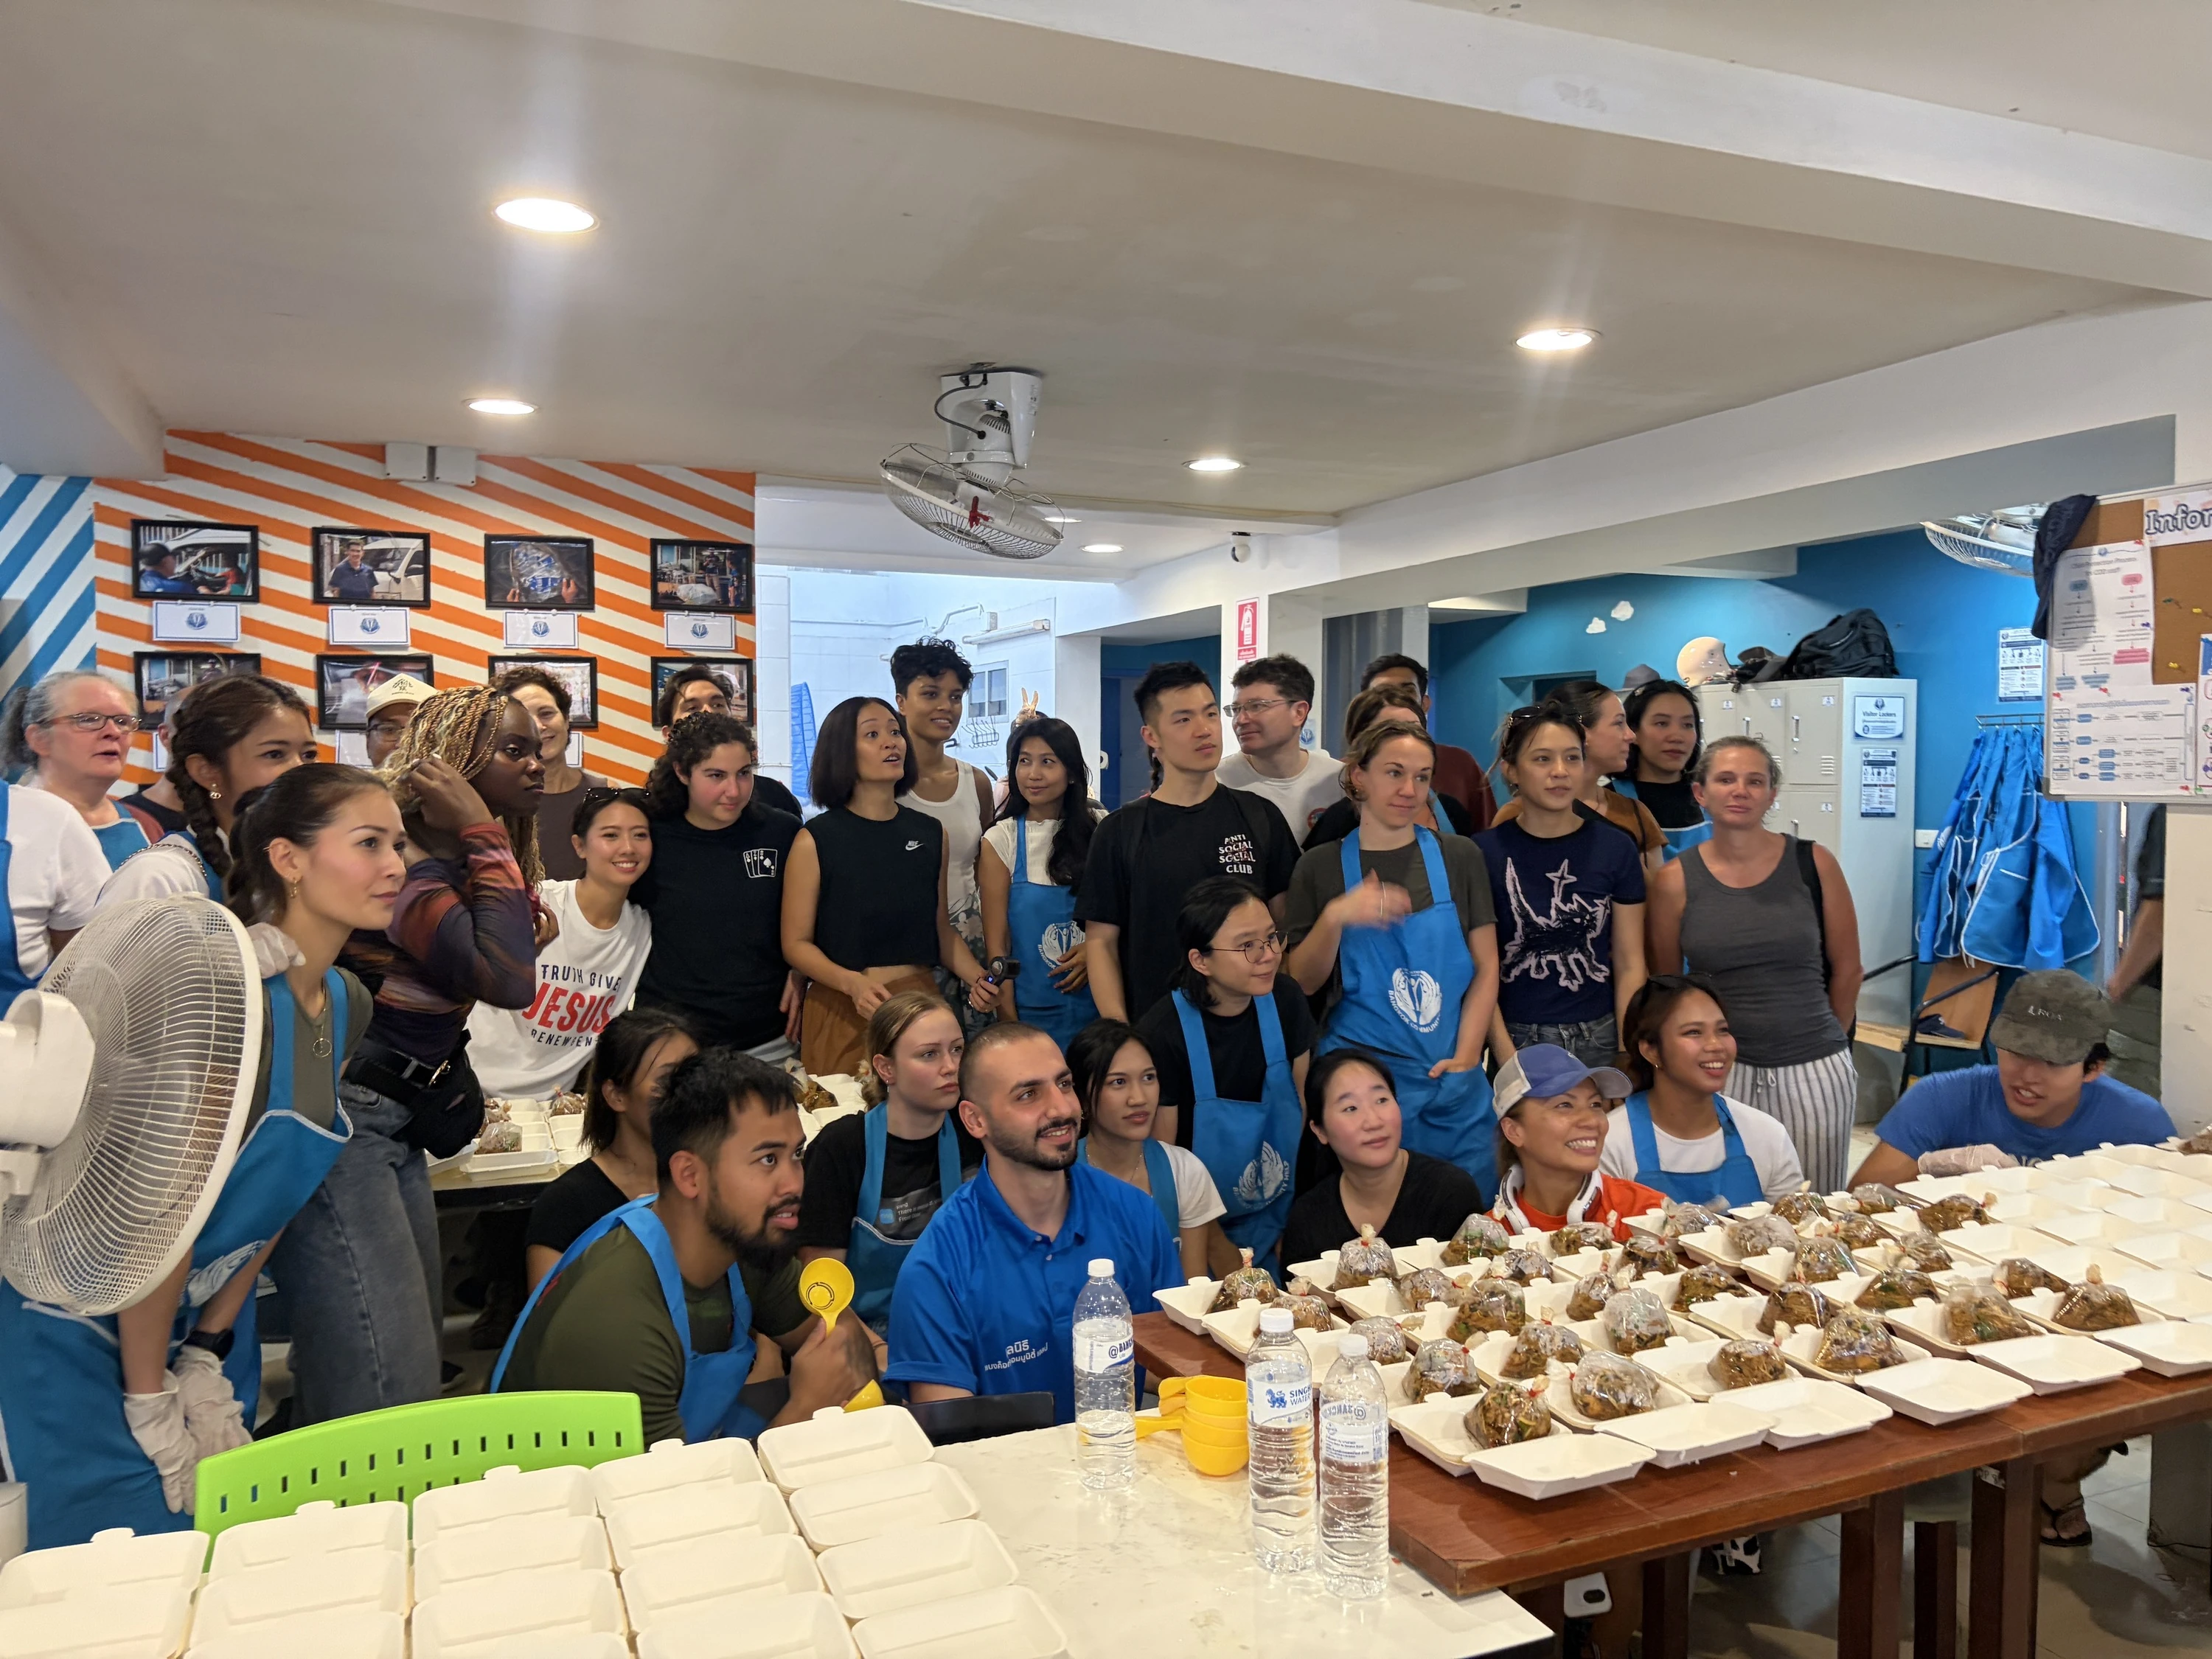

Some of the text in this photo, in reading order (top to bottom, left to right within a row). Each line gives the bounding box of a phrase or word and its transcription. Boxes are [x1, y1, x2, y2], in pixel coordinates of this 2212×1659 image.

[1225, 834, 1246, 844] ANTI
[1219, 841, 1253, 854] SOCIAL
[1219, 852, 1256, 863] SOCIAL
[1226, 864, 1253, 874] CLUB
[522, 982, 616, 1034] JESUS
